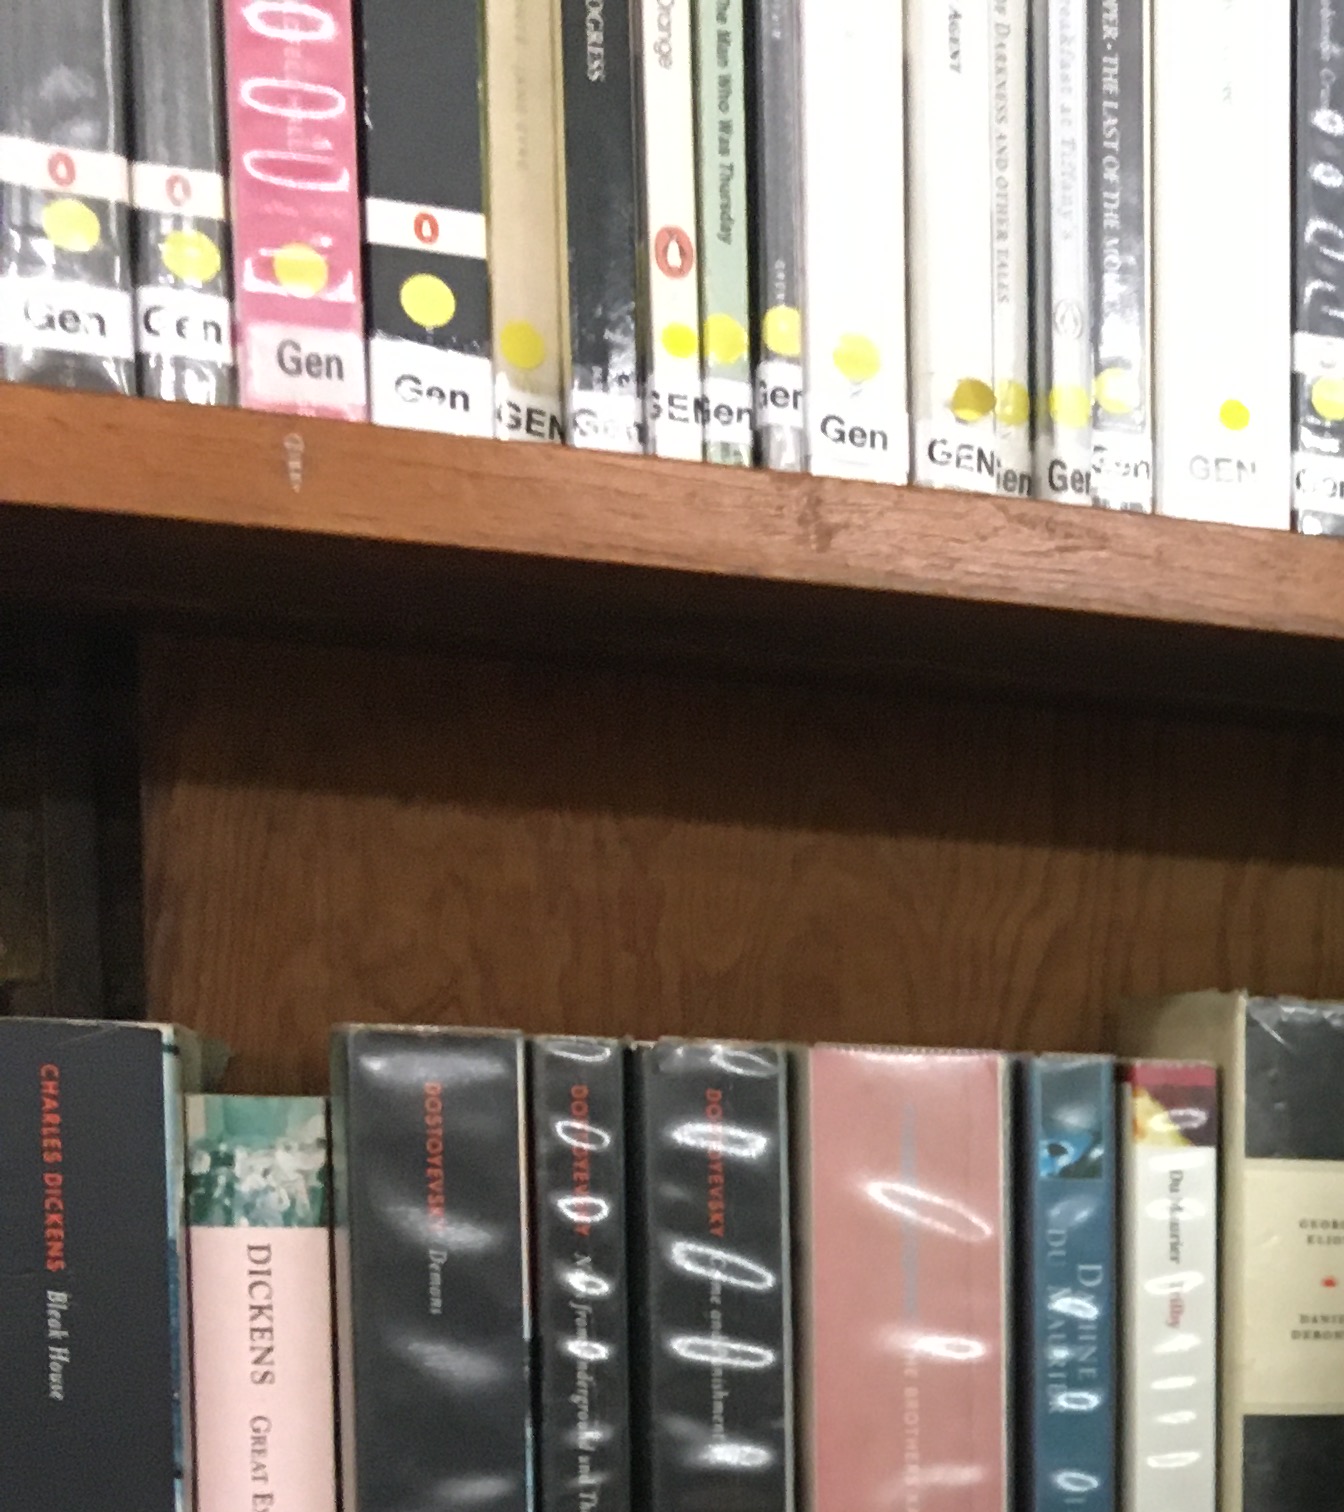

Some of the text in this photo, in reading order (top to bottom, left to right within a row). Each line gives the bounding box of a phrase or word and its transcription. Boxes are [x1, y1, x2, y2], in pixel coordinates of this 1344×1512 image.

[1102, 54, 1119, 95] THE
[716, 30, 735, 245] Man Who Was Thursday
[1102, 100, 1119, 151] LAST
[1103, 191, 1119, 229] THE
[277, 339, 345, 381] Gen
[394, 373, 470, 412] Gen
[820, 414, 888, 451] Gen
[927, 437, 995, 475] GEN
[1189, 454, 1257, 484] GEN
[425, 1082, 447, 1314] DOSTOYEVSKY Demons
[1167, 1169, 1184, 1194] Du
[41, 1064, 71, 1401] CHARLES DICKENS Bleak House
[247, 1243, 274, 1387] DICKENS
[1046, 1227, 1072, 1415] DU MAURIER
[249, 1415, 271, 1484] GREAT
[904, 1387, 920, 1483] BROTHERS
